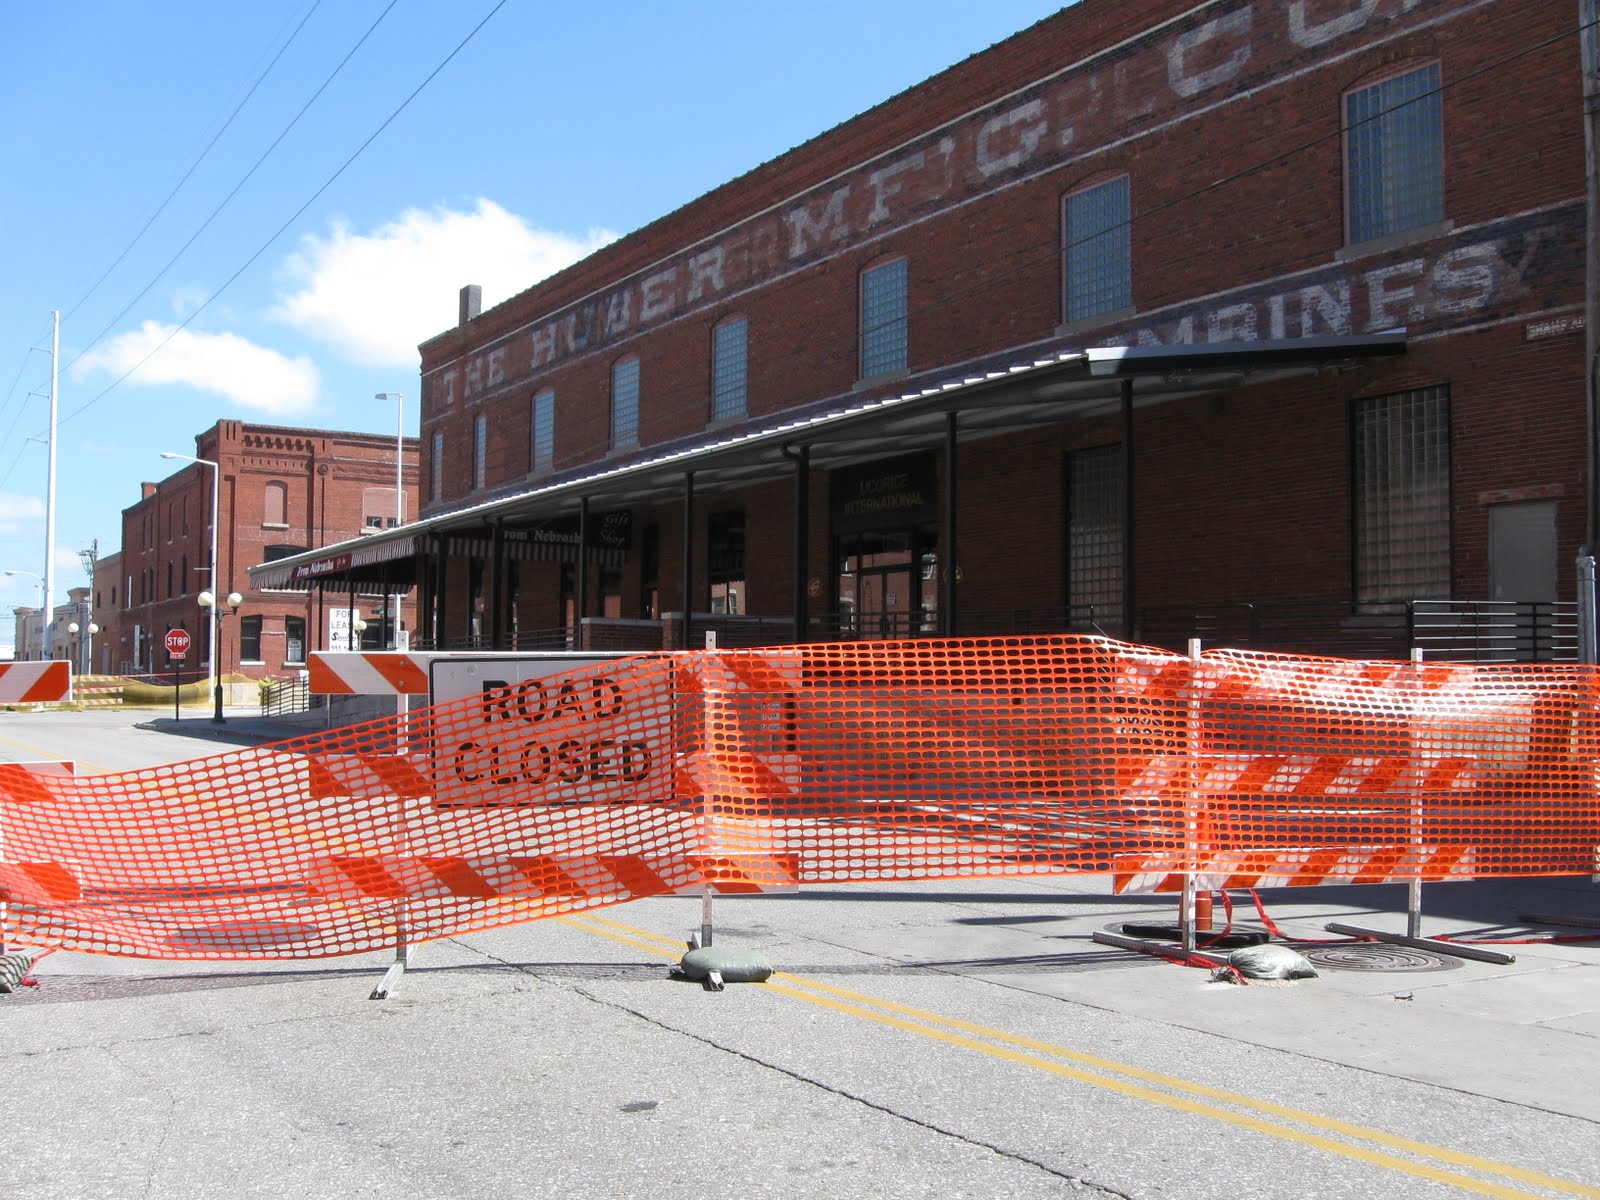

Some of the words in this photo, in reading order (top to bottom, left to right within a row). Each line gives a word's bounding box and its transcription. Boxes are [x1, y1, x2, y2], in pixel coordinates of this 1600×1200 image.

[531, 246, 725, 368] HUBER
[604, 512, 630, 528] Gift
[503, 529, 528, 541] rom
[534, 529, 582, 544] Nebrask
[600, 529, 626, 548] Shop
[167, 636, 188, 646] STOP
[482, 678, 623, 723] ROAD
[454, 740, 653, 785] CLOSED
